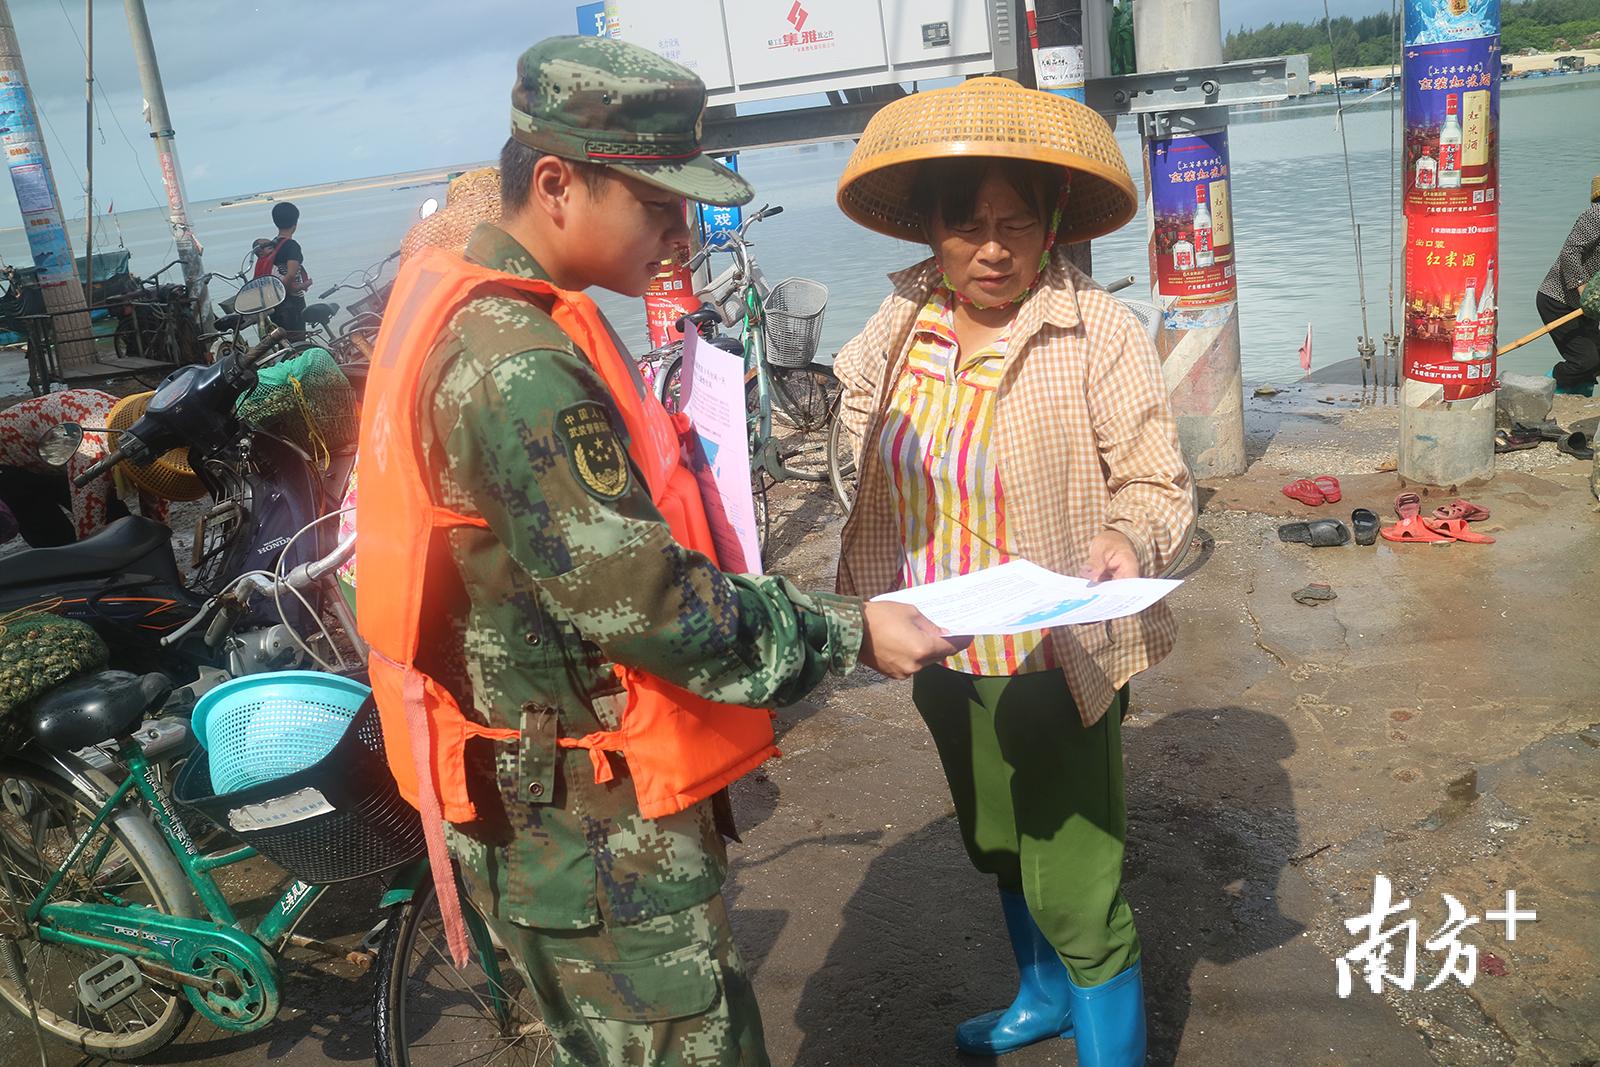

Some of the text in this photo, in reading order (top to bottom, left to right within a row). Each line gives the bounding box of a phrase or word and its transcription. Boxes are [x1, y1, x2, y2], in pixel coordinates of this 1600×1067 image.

[1426, 251, 1476, 268] 红米酒
[257, 536, 292, 555] HONDA
